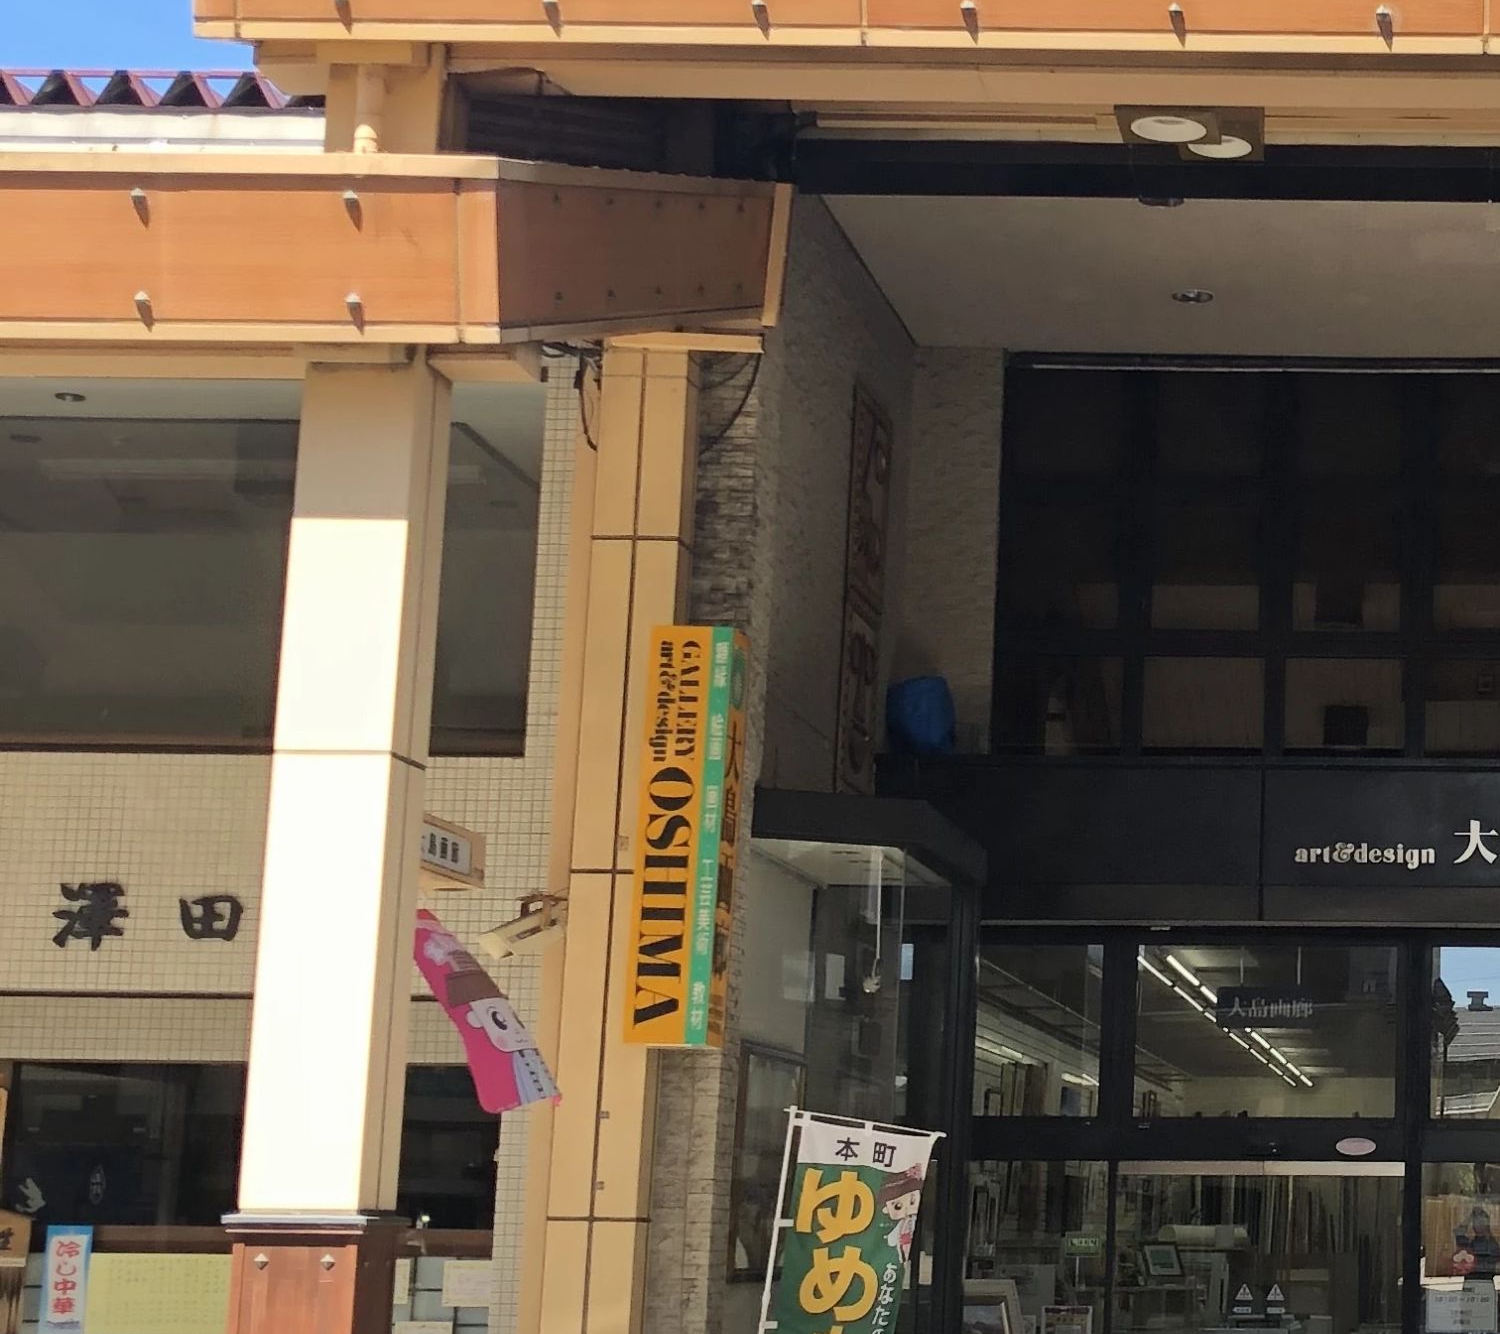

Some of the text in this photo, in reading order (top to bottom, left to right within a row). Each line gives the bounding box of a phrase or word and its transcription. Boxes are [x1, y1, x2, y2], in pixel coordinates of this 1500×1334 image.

[649, 640, 676, 763] art&design
[674, 640, 702, 760] GALLERY
[633, 766, 696, 1030] OSHIMA
[1294, 842, 1436, 870] art&design
[835, 1136, 897, 1168] 本町
[52, 1240, 82, 1315] 冷し中華
